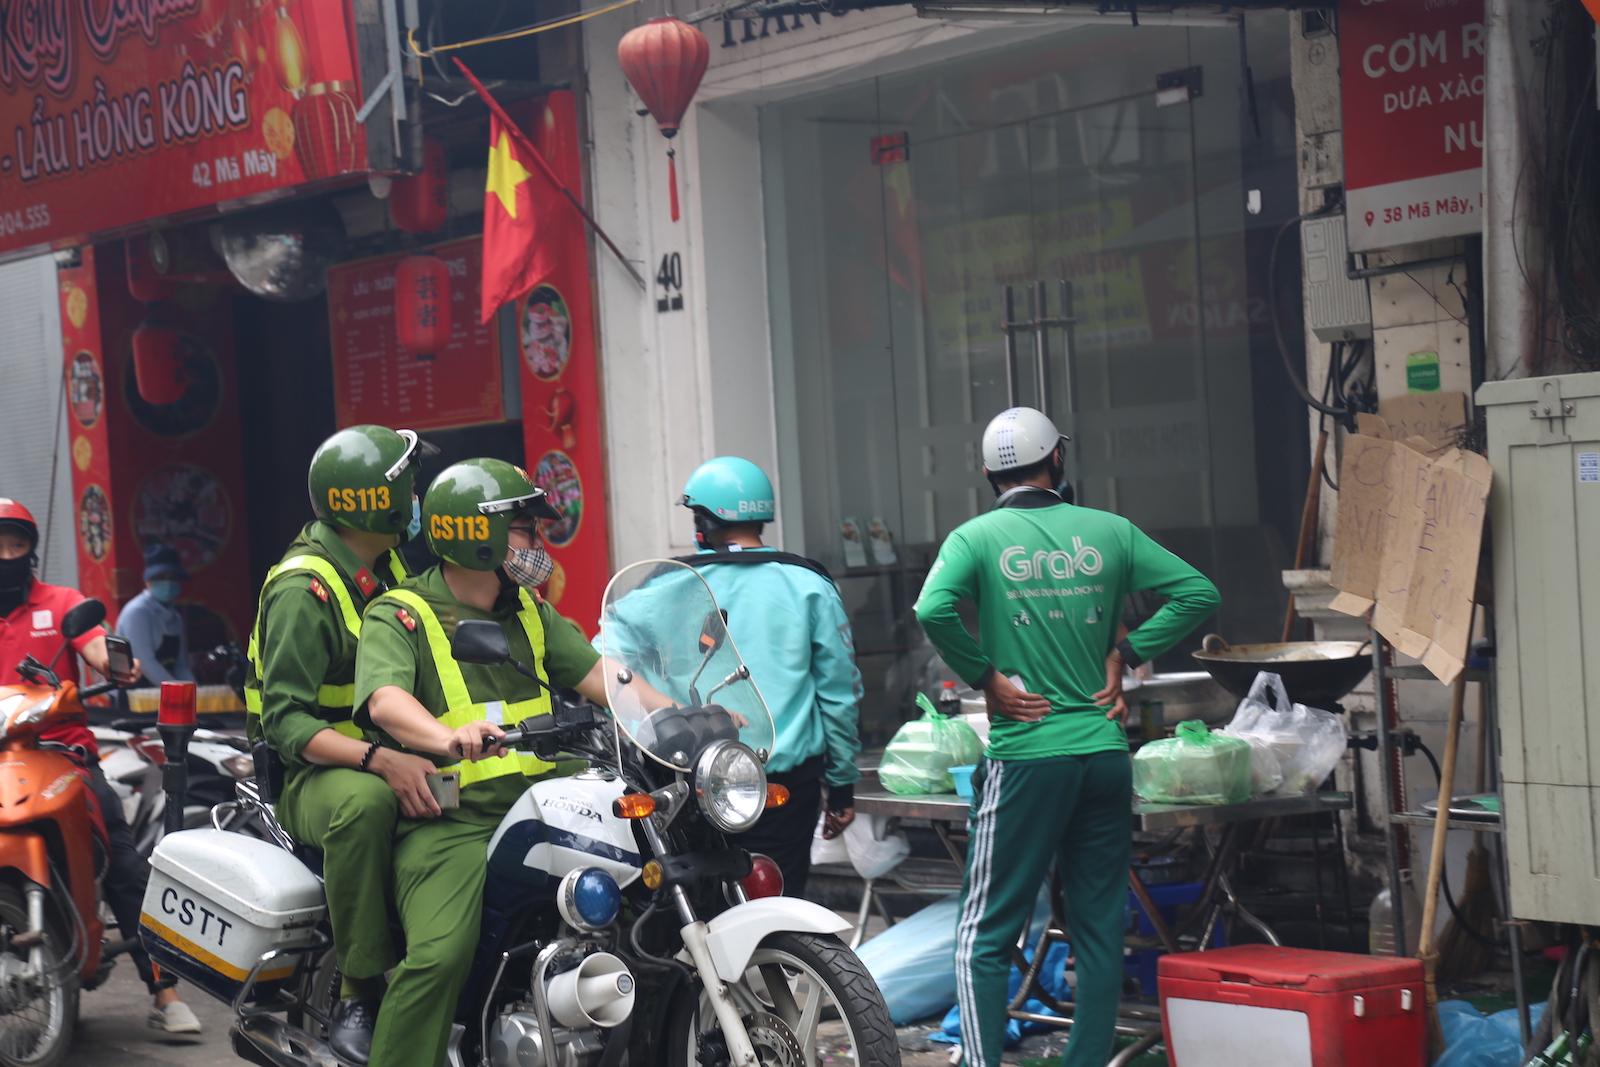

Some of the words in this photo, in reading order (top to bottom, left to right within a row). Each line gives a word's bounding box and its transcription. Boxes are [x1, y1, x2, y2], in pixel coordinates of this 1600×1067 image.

[1362, 30, 1447, 78] CƠM
[1383, 85, 1432, 113] DƯA
[1439, 73, 1485, 103] XÀO
[15, 97, 70, 180] LẨU
[72, 78, 154, 169] HỒNG
[158, 61, 247, 142] KÔNG
[192, 162, 213, 188] 42
[215, 157, 240, 184] Mã
[243, 150, 277, 178] Mây
[1383, 206, 1403, 223] 38
[1408, 201, 1431, 219] Mã
[1436, 195, 1474, 215] Mây,
[655, 252, 683, 291] 40
[328, 486, 391, 511] CS113
[430, 514, 490, 541] CS113
[999, 536, 1103, 582] Grab
[541, 799, 603, 824] HONDA
[161, 887, 233, 947] CSTT
